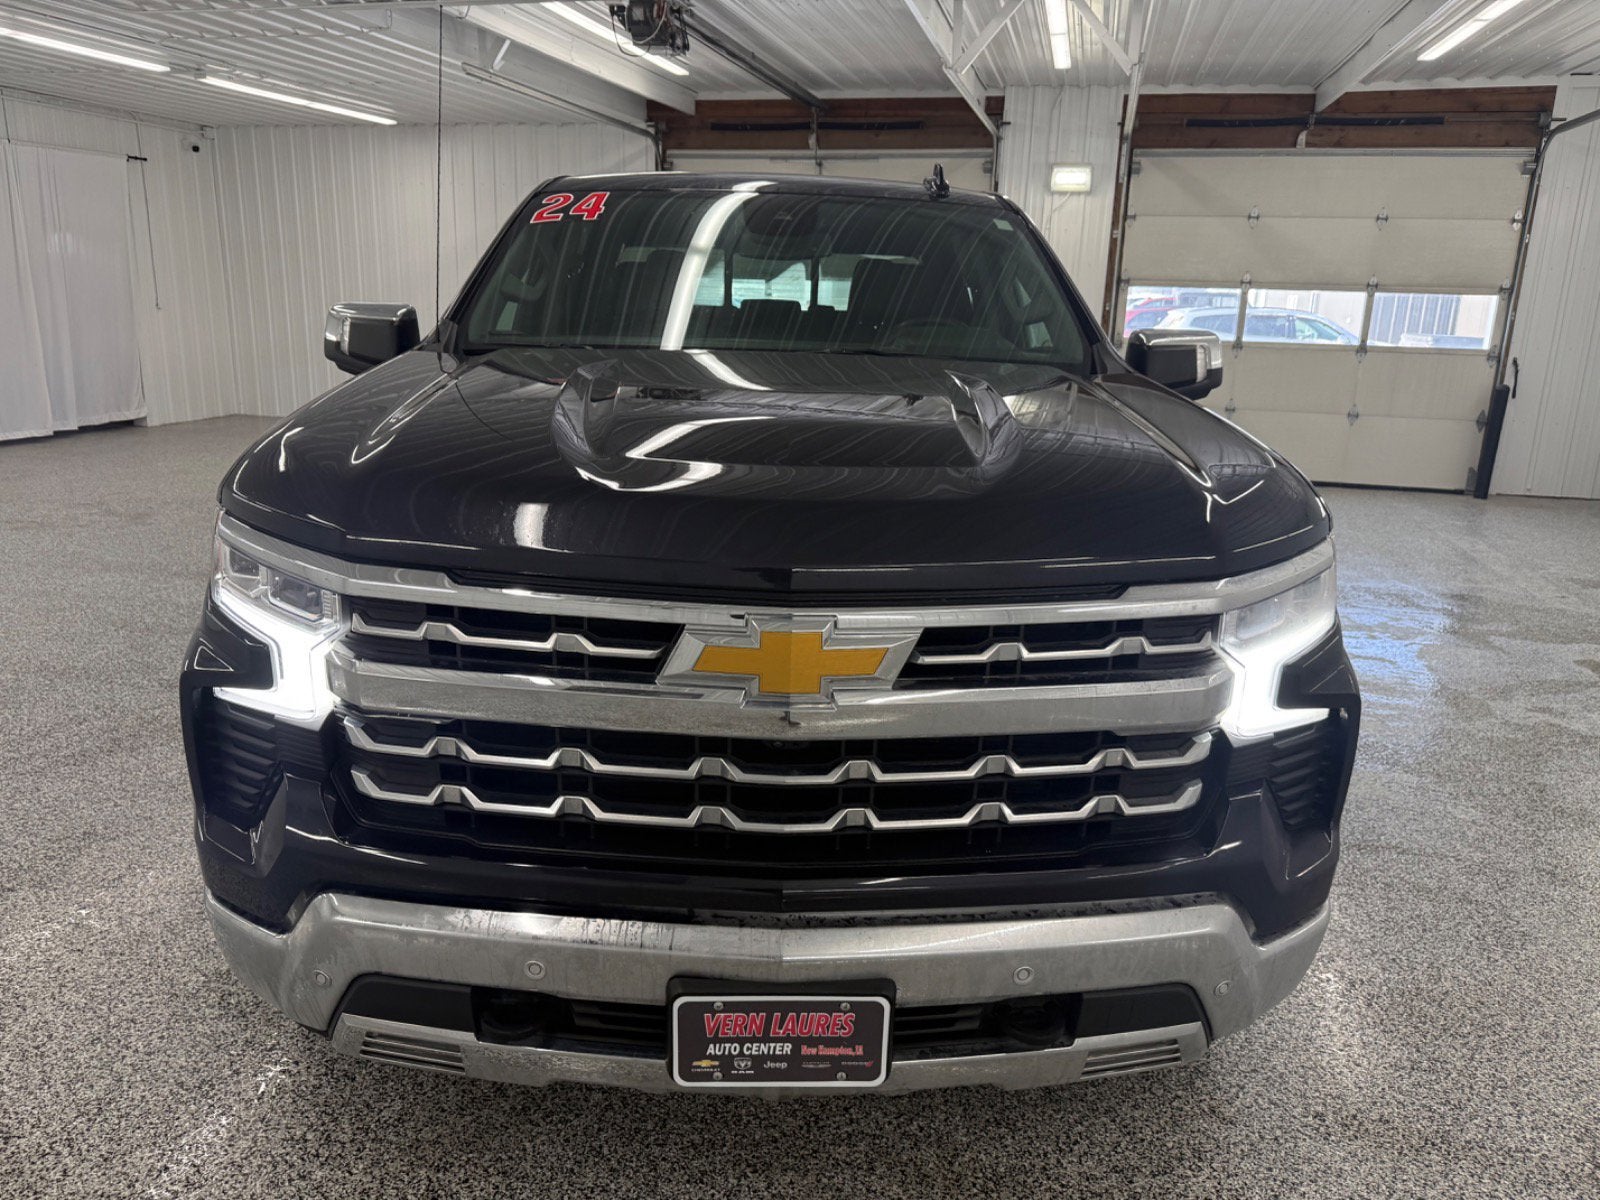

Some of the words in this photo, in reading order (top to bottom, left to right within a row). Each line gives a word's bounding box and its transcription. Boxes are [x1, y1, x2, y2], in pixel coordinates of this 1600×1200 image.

[530, 191, 610, 224] 24
[704, 1013, 765, 1037] VERN
[769, 1012, 855, 1037] LAURES
[706, 1043, 740, 1056] AUTO
[742, 1043, 792, 1055] CENTER
[801, 1045, 817, 1055] New
[763, 1061, 788, 1069] Jeep
